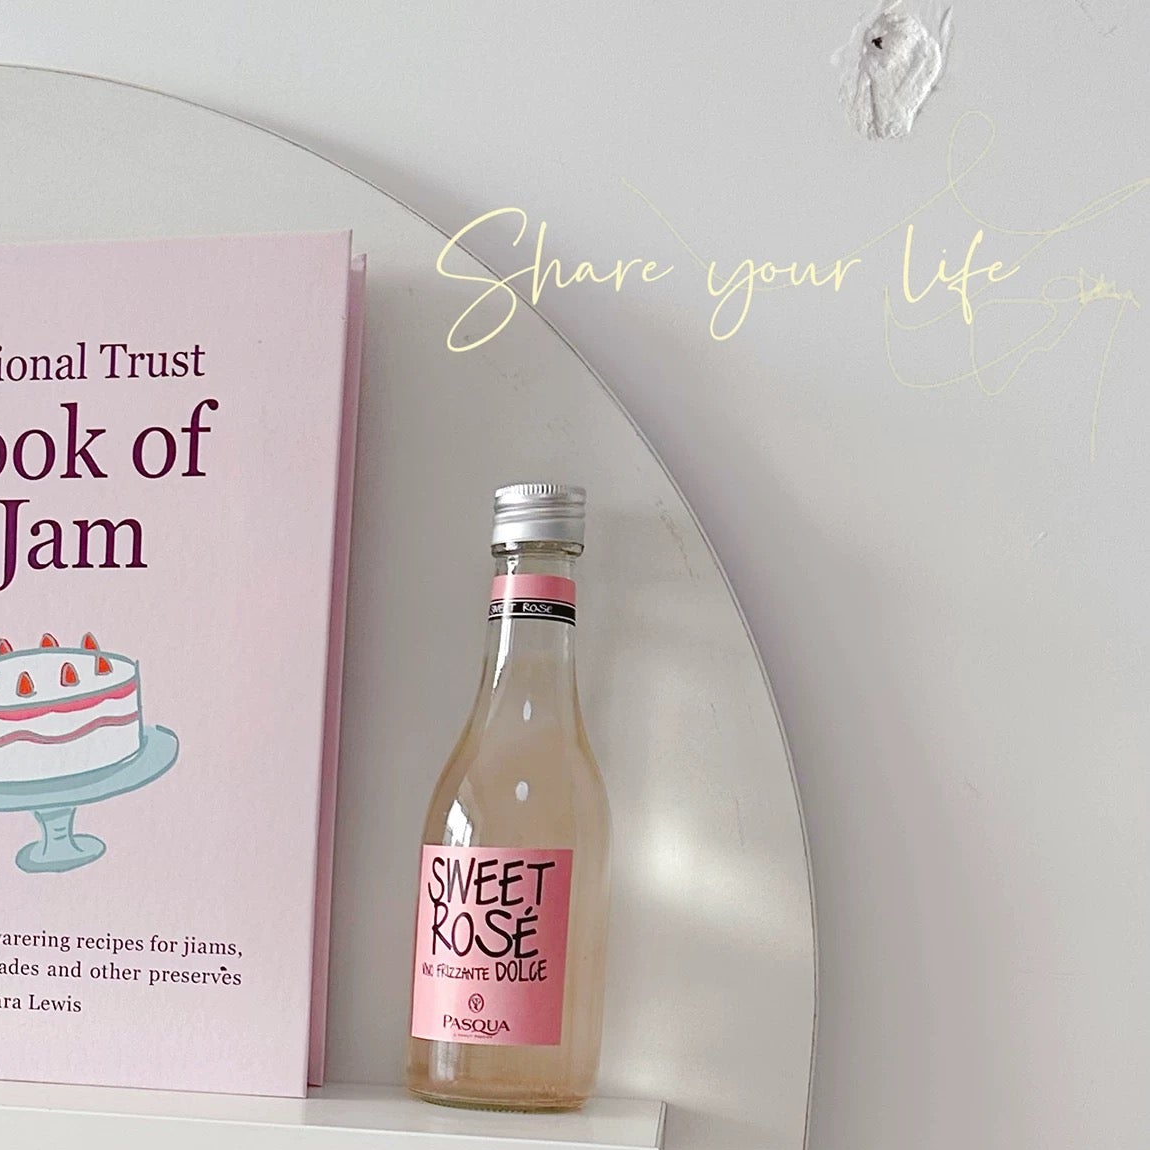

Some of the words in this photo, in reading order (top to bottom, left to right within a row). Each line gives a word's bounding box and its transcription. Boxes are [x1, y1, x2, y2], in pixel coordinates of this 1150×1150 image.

[100, 343, 206, 379] Trust
[133, 398, 219, 479] of
[428, 857, 555, 906] SWEET
[432, 902, 539, 958] ROSÉ
[77, 933, 144, 954] recipes
[150, 935, 178, 952] for
[182, 936, 242, 958] jiams,
[47, 961, 82, 977] and
[90, 962, 141, 980] other
[149, 968, 242, 985] preserves
[437, 963, 489, 981] FRIZZANTE
[495, 959, 547, 982] DOLCE
[29, 994, 82, 1012] Lewis
[443, 1015, 510, 1035] PASQUA
